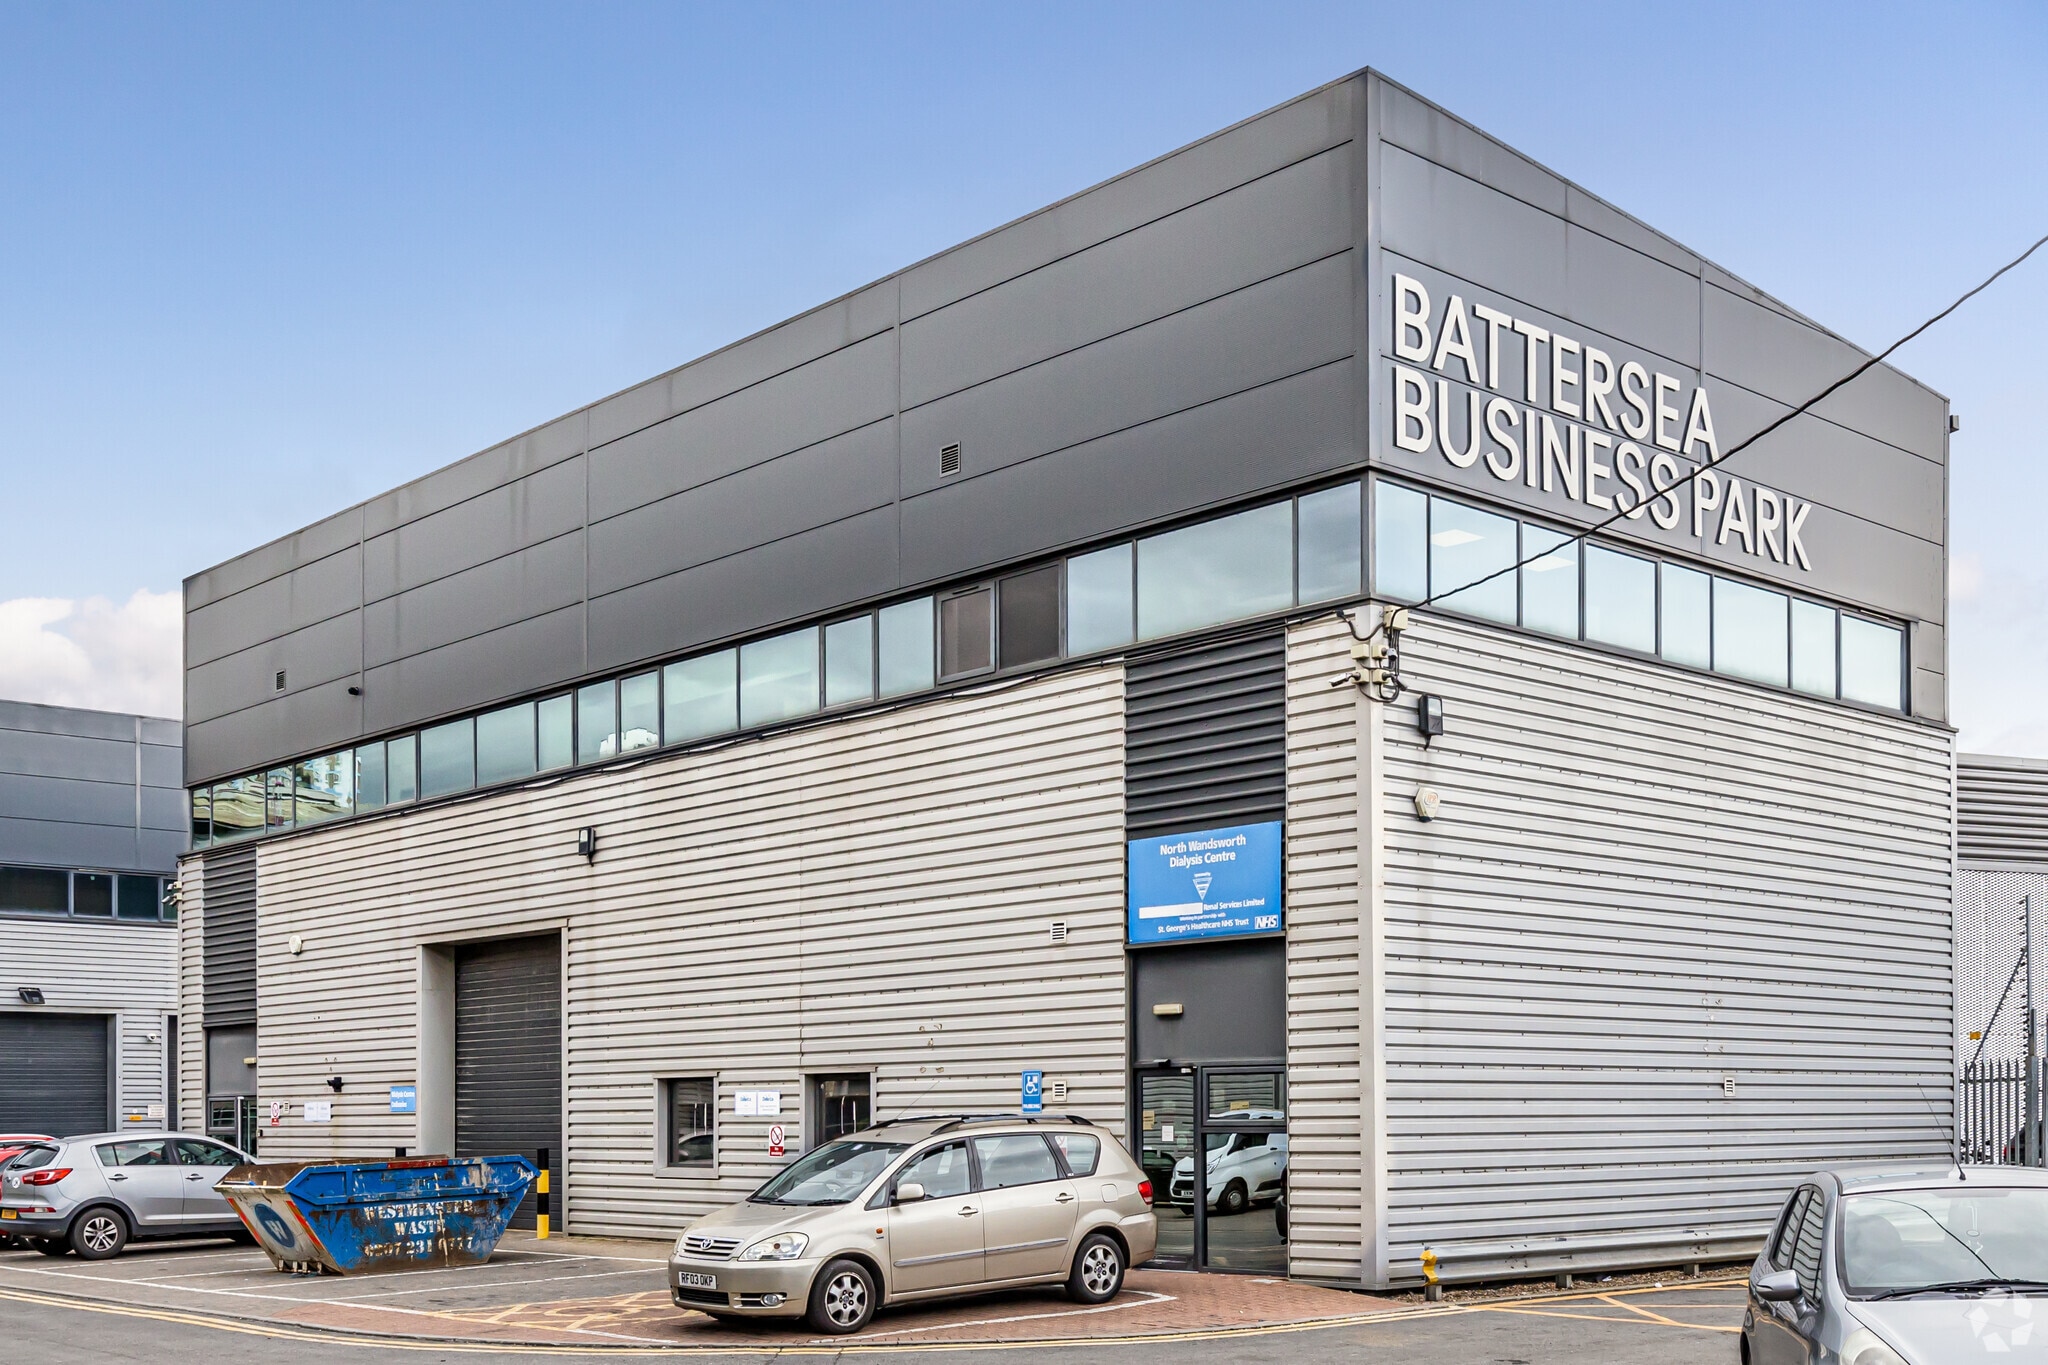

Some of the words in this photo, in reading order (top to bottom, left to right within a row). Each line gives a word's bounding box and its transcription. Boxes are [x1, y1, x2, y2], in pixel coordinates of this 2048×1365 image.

[1394, 273, 1720, 462] BATTERSEA
[1394, 365, 1680, 530] BUSINESS
[1691, 466, 1811, 571] PARK
[1160, 842, 1186, 855] North
[1188, 834, 1246, 851] Wandsworth
[1170, 854, 1203, 868] Dialysis
[1204, 851, 1236, 864] Centre
[1203, 902, 1219, 911] Renal
[1219, 900, 1242, 909] Services
[1243, 898, 1265, 907] Limited
[1190, 921, 1220, 930] Healthcare
[1221, 919, 1234, 927] NHS
[1234, 918, 1249, 926] Trust
[1255, 916, 1278, 928] NHS
[363, 1200, 473, 1221] WESTMINSTER
[394, 1219, 446, 1236] WASTE
[406, 1239, 433, 1255] 231
[681, 1272, 699, 1285] RF03
[700, 1274, 714, 1287] OKP
